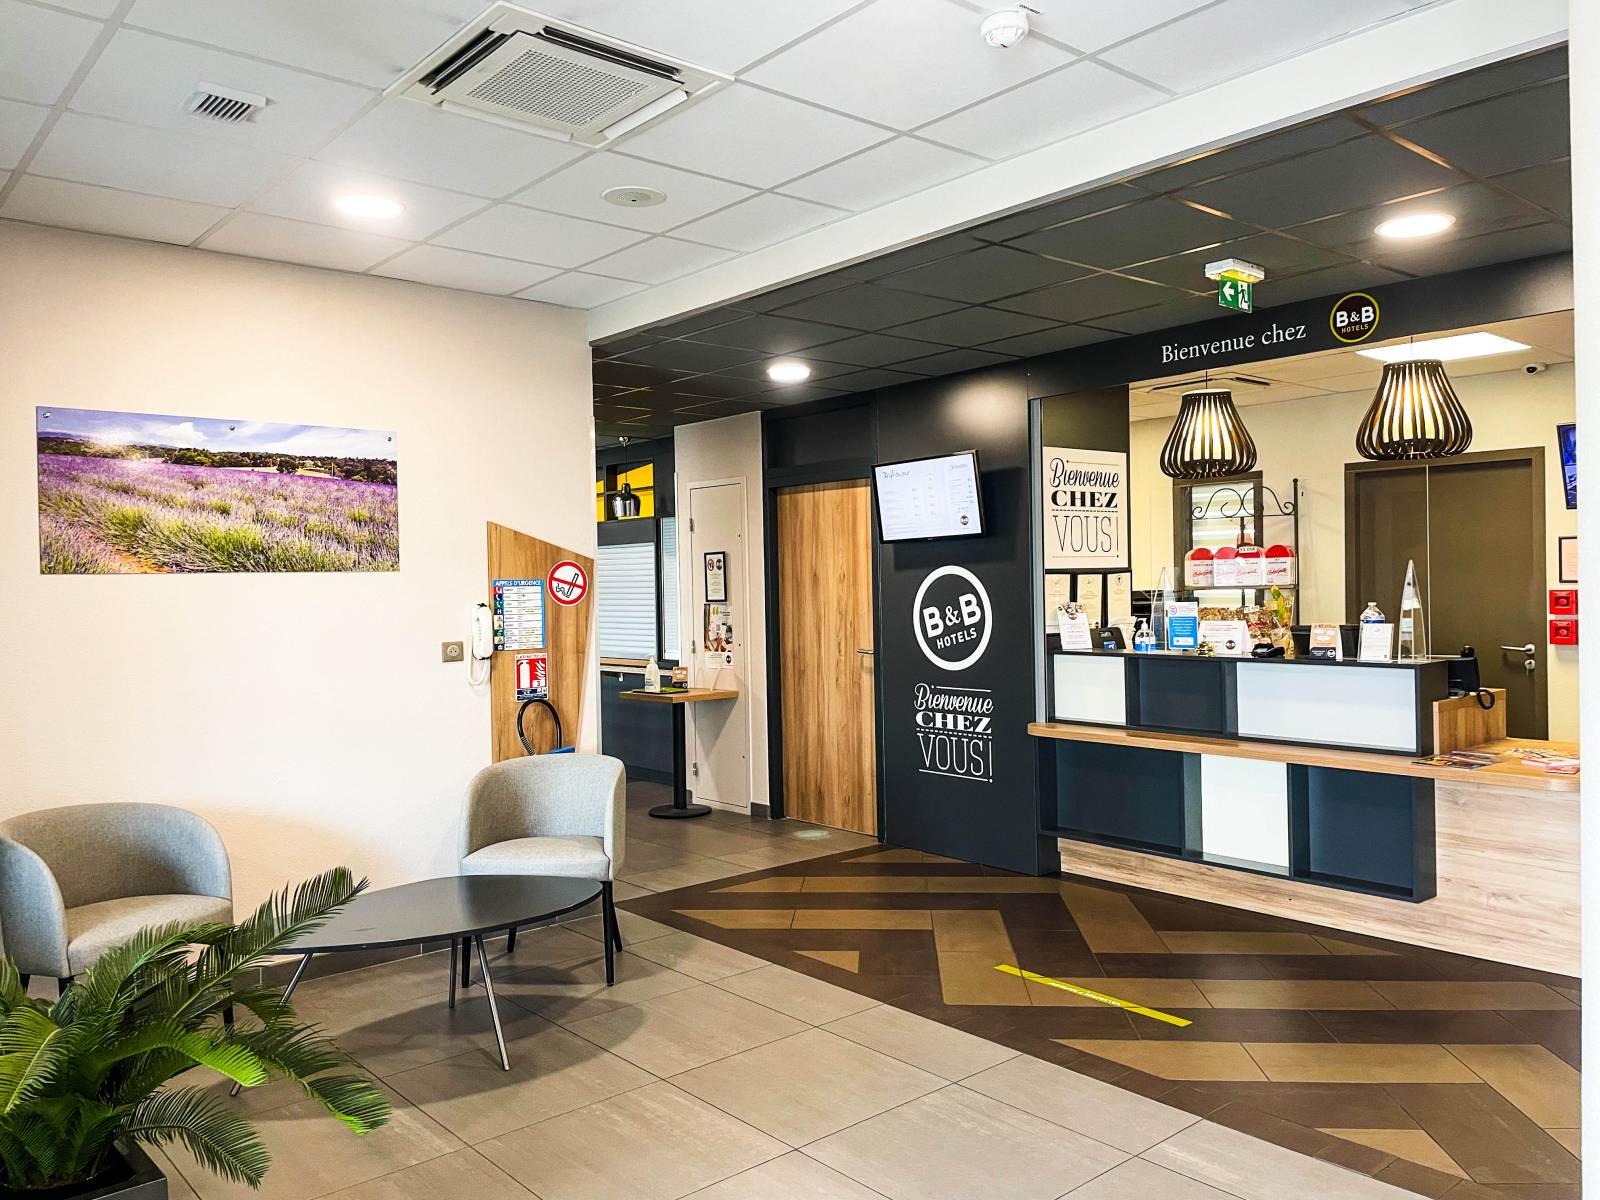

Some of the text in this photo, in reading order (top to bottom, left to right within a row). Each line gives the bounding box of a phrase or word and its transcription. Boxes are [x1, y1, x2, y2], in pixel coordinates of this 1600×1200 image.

[1336, 306, 1375, 328] B&B
[1341, 323, 1369, 334] HOTELS
[1161, 323, 1307, 363] Bienvenue chez
[1049, 457, 1121, 488] Bienvenue
[1051, 489, 1118, 508] CHEZ
[922, 593, 982, 639] B&B
[936, 627, 977, 650] HOTELS
[913, 682, 994, 714] Bienvenue
[915, 710, 992, 734] CHEZ
